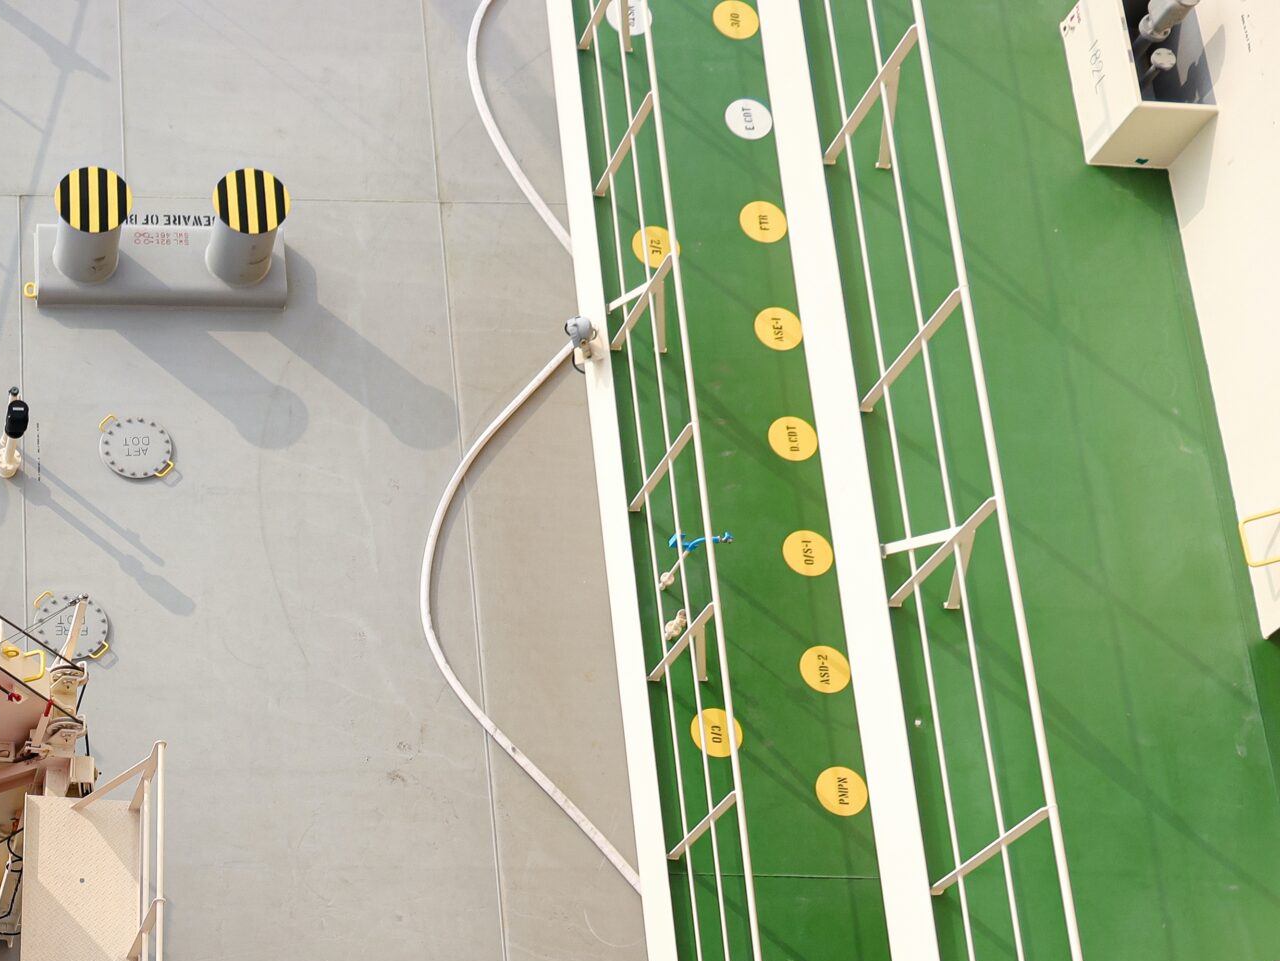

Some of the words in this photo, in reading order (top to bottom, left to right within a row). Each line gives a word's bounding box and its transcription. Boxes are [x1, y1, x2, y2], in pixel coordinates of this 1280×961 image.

[142, 213, 159, 226] OF
[125, 447, 149, 457] AFT
[56, 625, 89, 637] FRE
